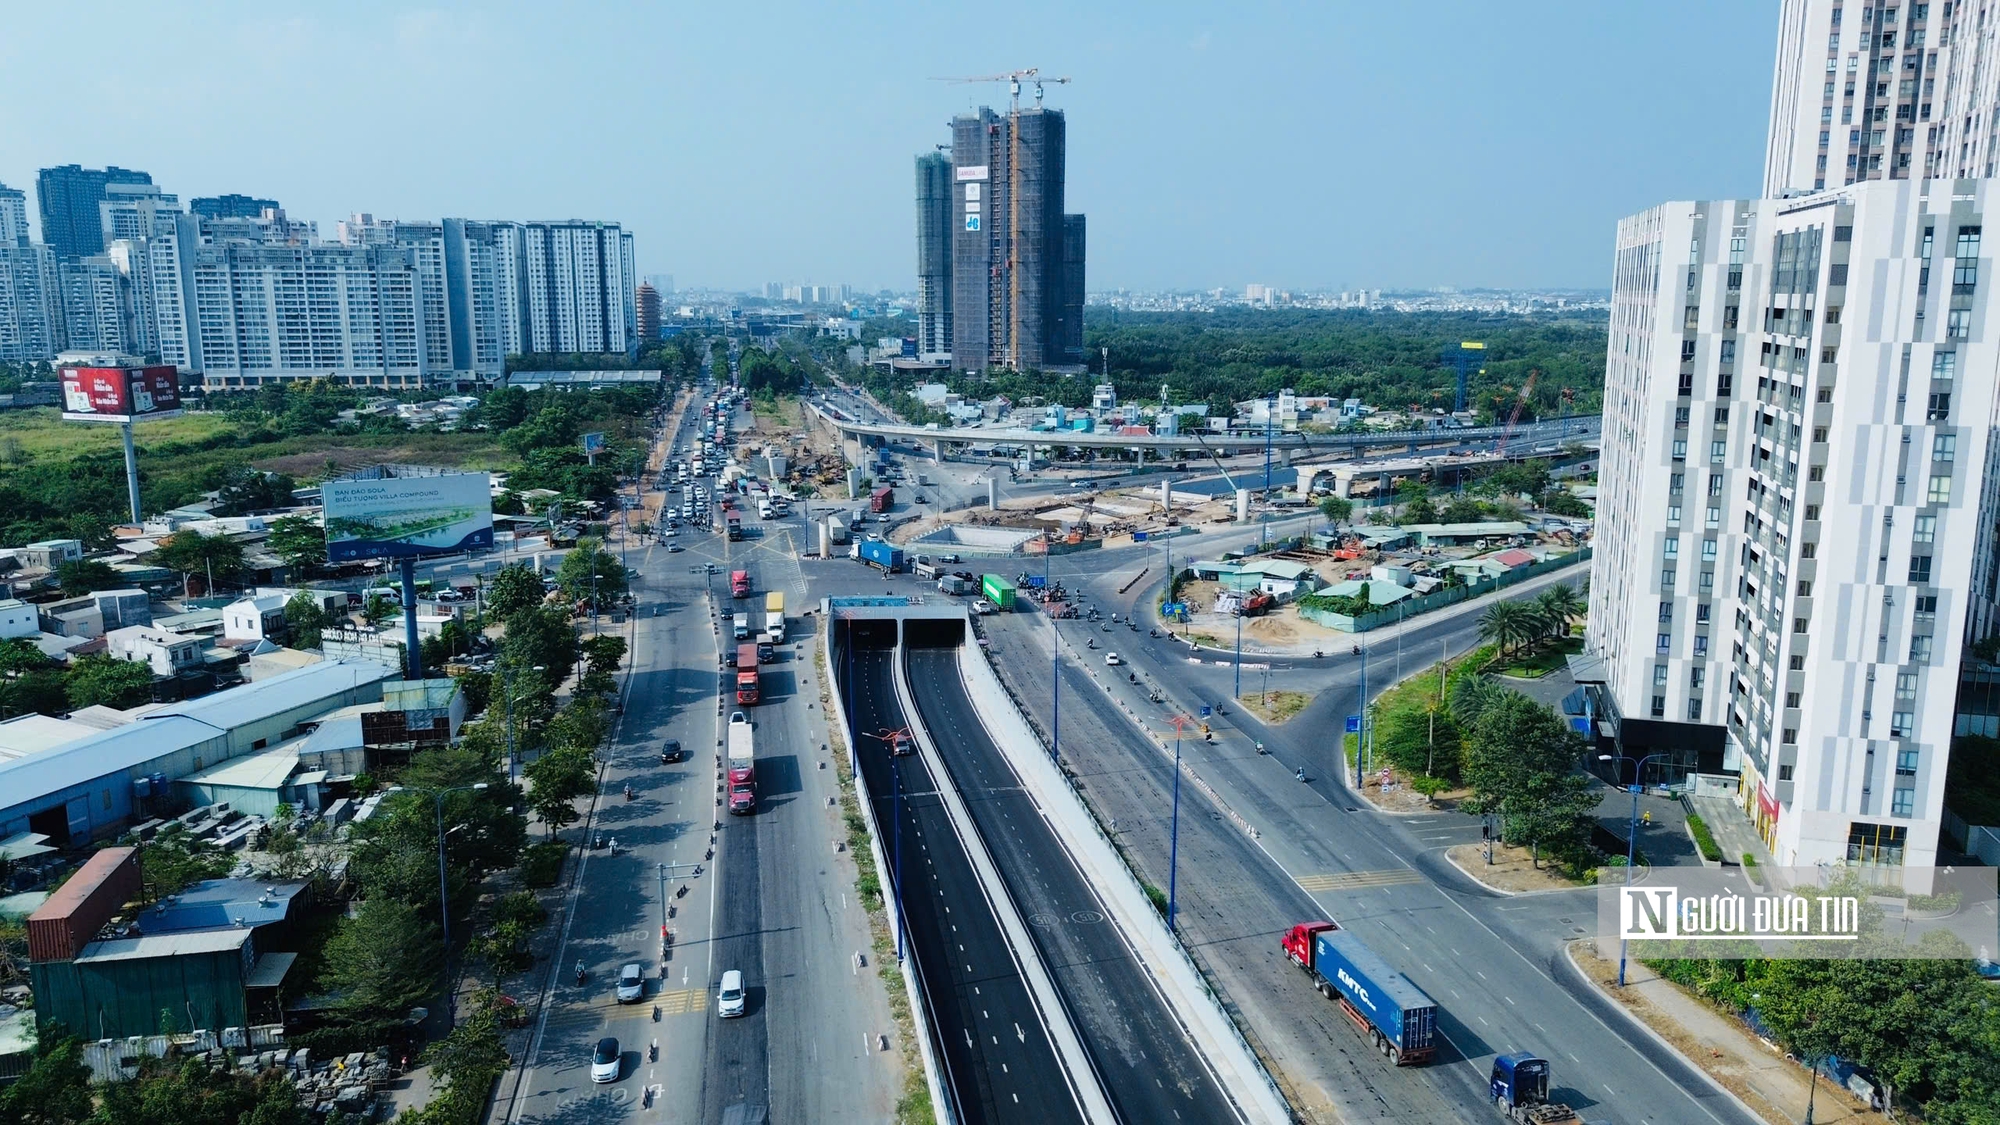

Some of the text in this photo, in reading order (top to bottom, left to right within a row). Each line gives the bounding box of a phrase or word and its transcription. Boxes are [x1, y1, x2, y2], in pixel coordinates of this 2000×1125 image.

[380, 493, 398, 501] VILLA
[399, 490, 439, 499] COMPOUND
[1337, 967, 1369, 1003] KMTC
